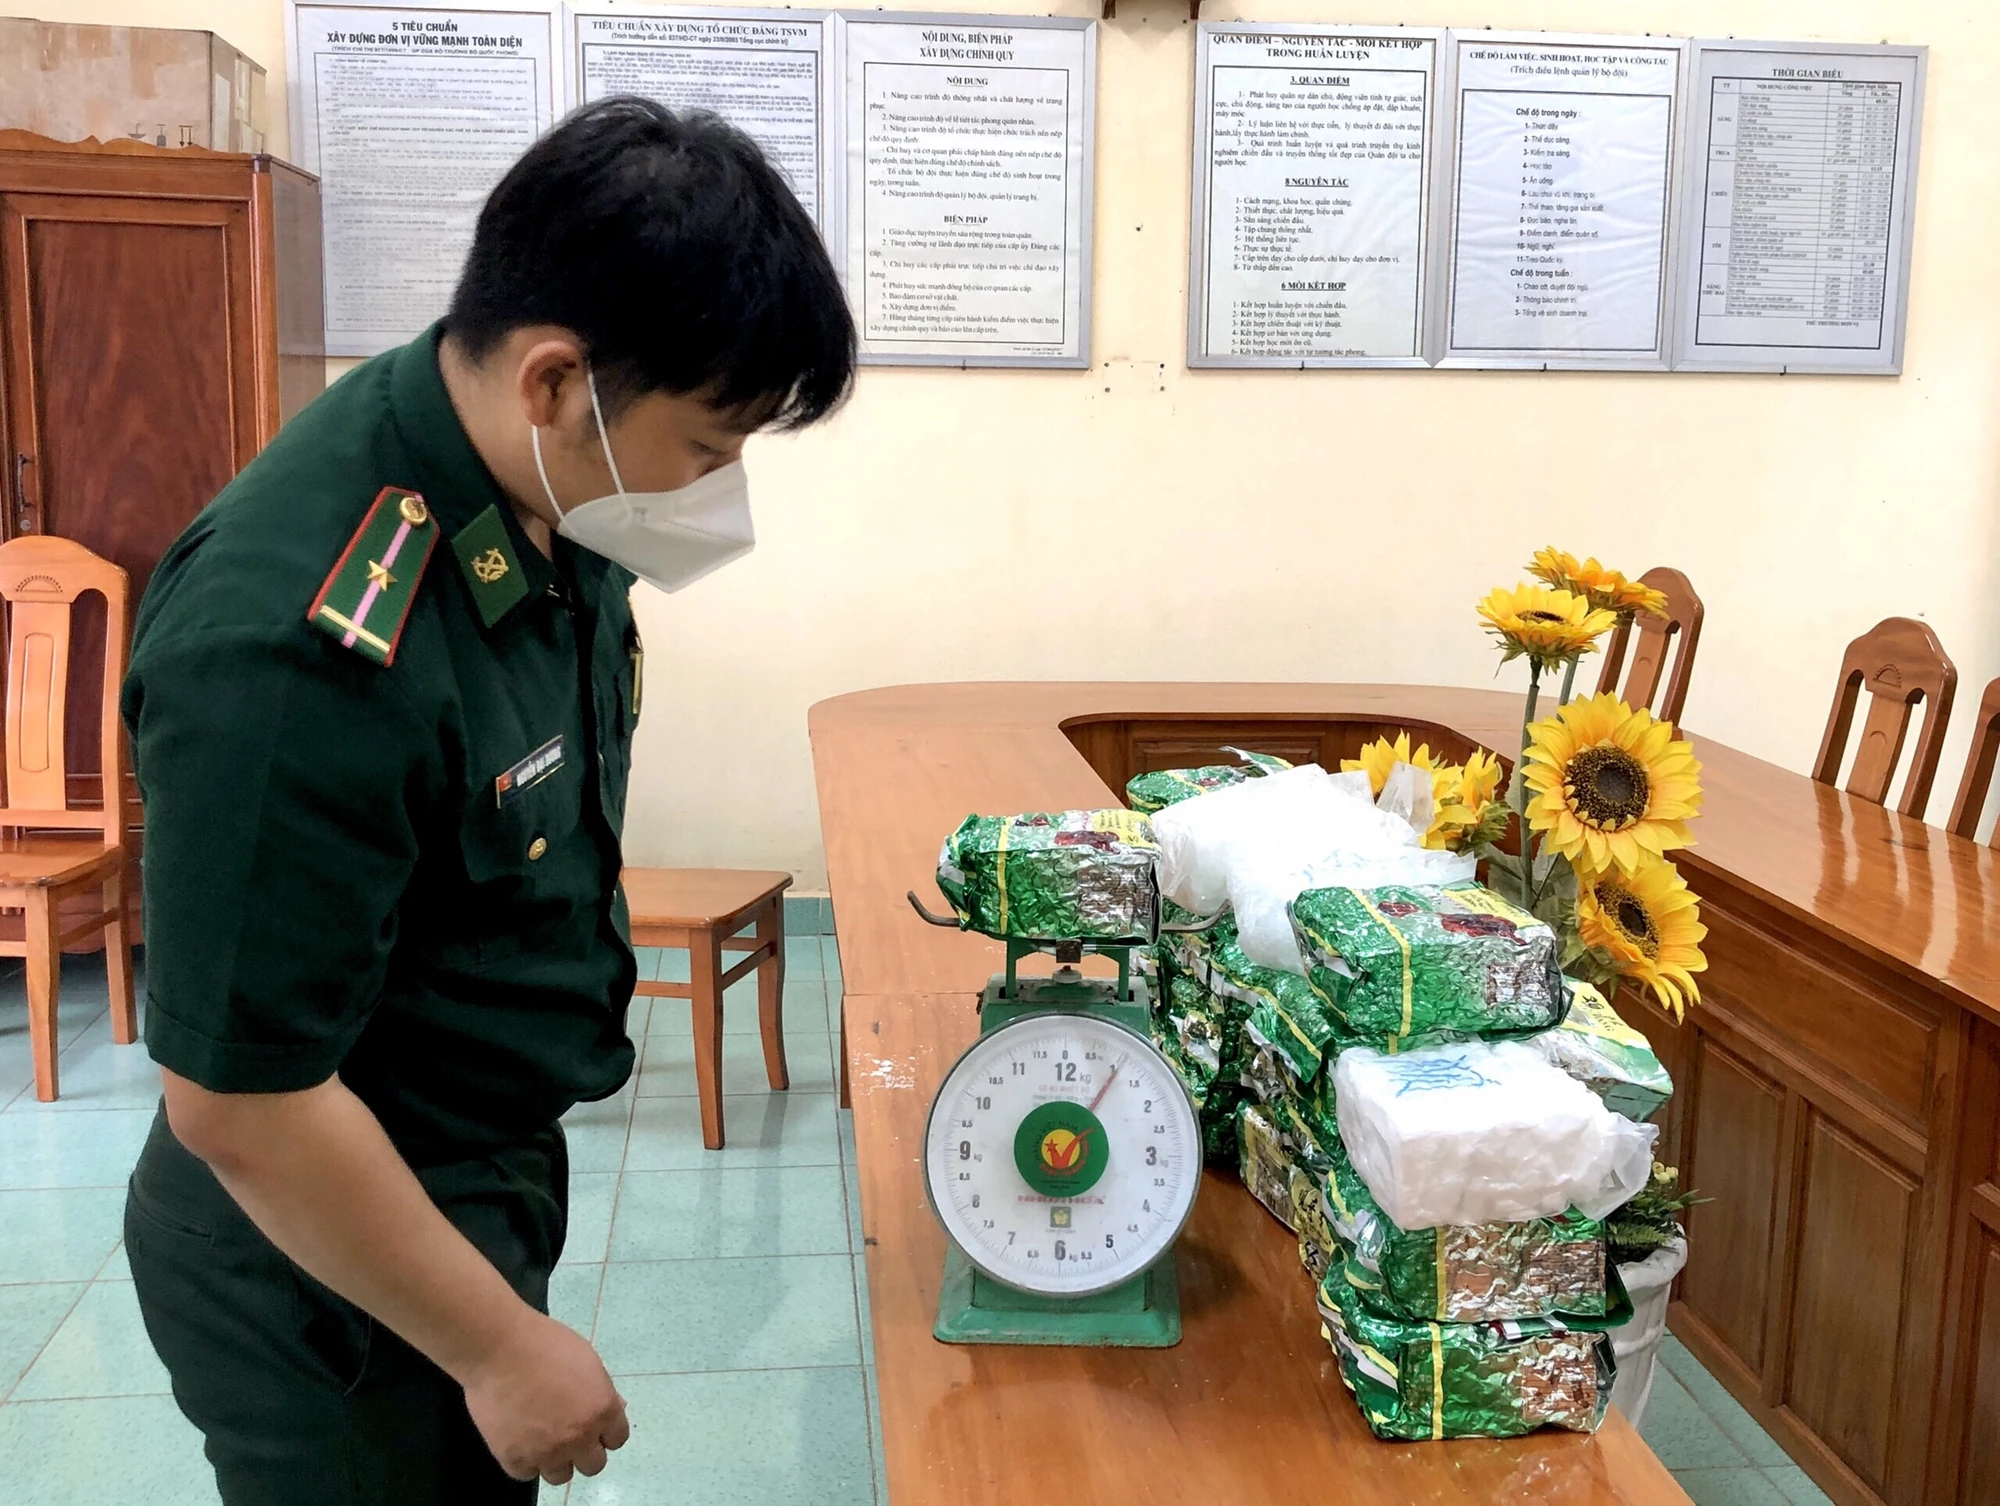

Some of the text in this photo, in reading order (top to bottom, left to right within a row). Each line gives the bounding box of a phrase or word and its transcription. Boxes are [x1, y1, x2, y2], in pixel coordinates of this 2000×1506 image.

[392, 19, 458, 32] 5 TIÊU CHUẨN
[328, 30, 522, 49] XÂY DỰNG ĐƠN VỊ VỮNG MẠNH TOÀN DIỆN
[1213, 34, 1242, 45] QUAN
[946, 76, 962, 86] NỘI
[1516, 107, 1577, 119] Chế độ trong ngày
[944, 214, 964, 224] BIỆN
[1033, 1051, 1047, 1059] 11,5
[1062, 1050, 1068, 1060] 0
[1086, 1052, 1096, 1060] 0,5
[1012, 1062, 1025, 1075] 11
[1055, 1062, 1091, 1084] 12 kg
[1129, 1080, 1140, 1088] 1,5
[976, 1097, 991, 1110] 10
[1144, 1100, 1152, 1113] 2
[1154, 1126, 1165, 1134] 2,5
[960, 1141, 982, 1162] 9 kg
[1146, 1147, 1157, 1165] 3
[1154, 1178, 1165, 1186] 3,5
[1127, 1224, 1138, 1232] 4,5
[1008, 1232, 1016, 1245] 7
[1106, 1234, 1114, 1248] 5
[1055, 1240, 1066, 1260] 6
[1081, 1251, 1092, 1260] 5,5
